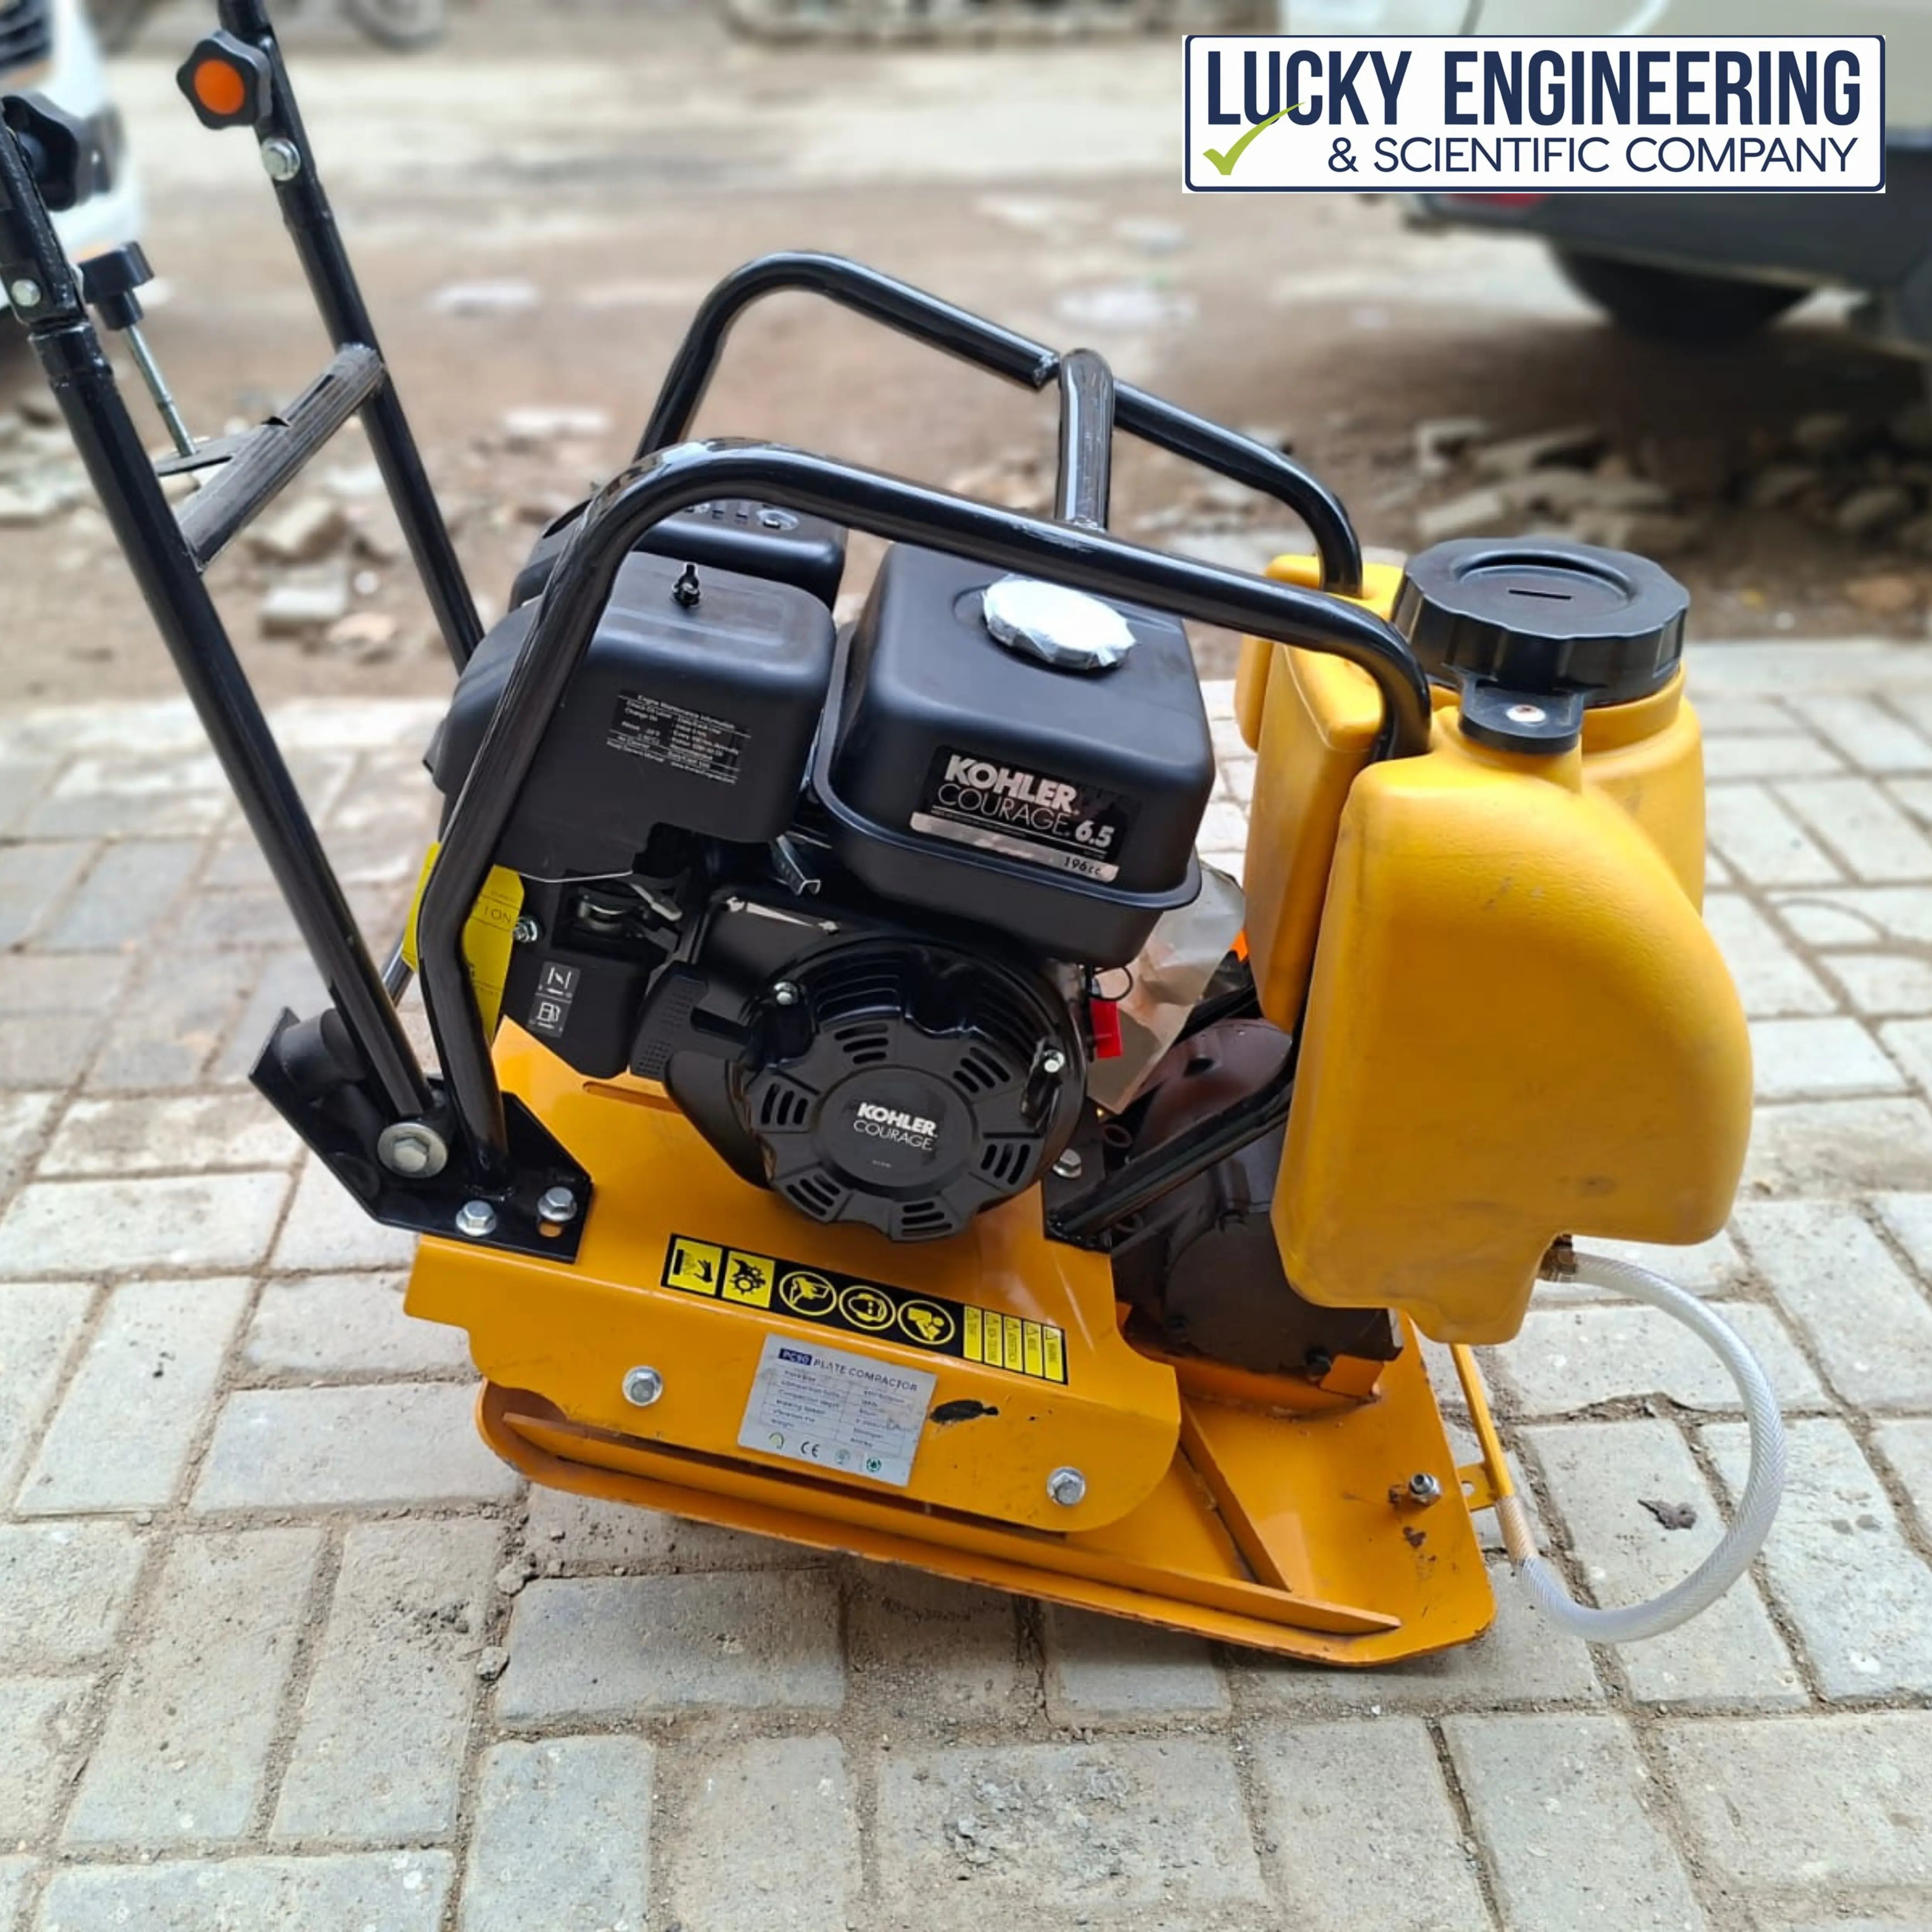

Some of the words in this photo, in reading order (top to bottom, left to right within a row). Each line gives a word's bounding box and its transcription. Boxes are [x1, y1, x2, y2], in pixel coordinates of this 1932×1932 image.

[1075, 820, 1116, 848] 6.5
[1063, 856, 1101, 875] 196cc
[853, 1120, 932, 1151] COURAGE
